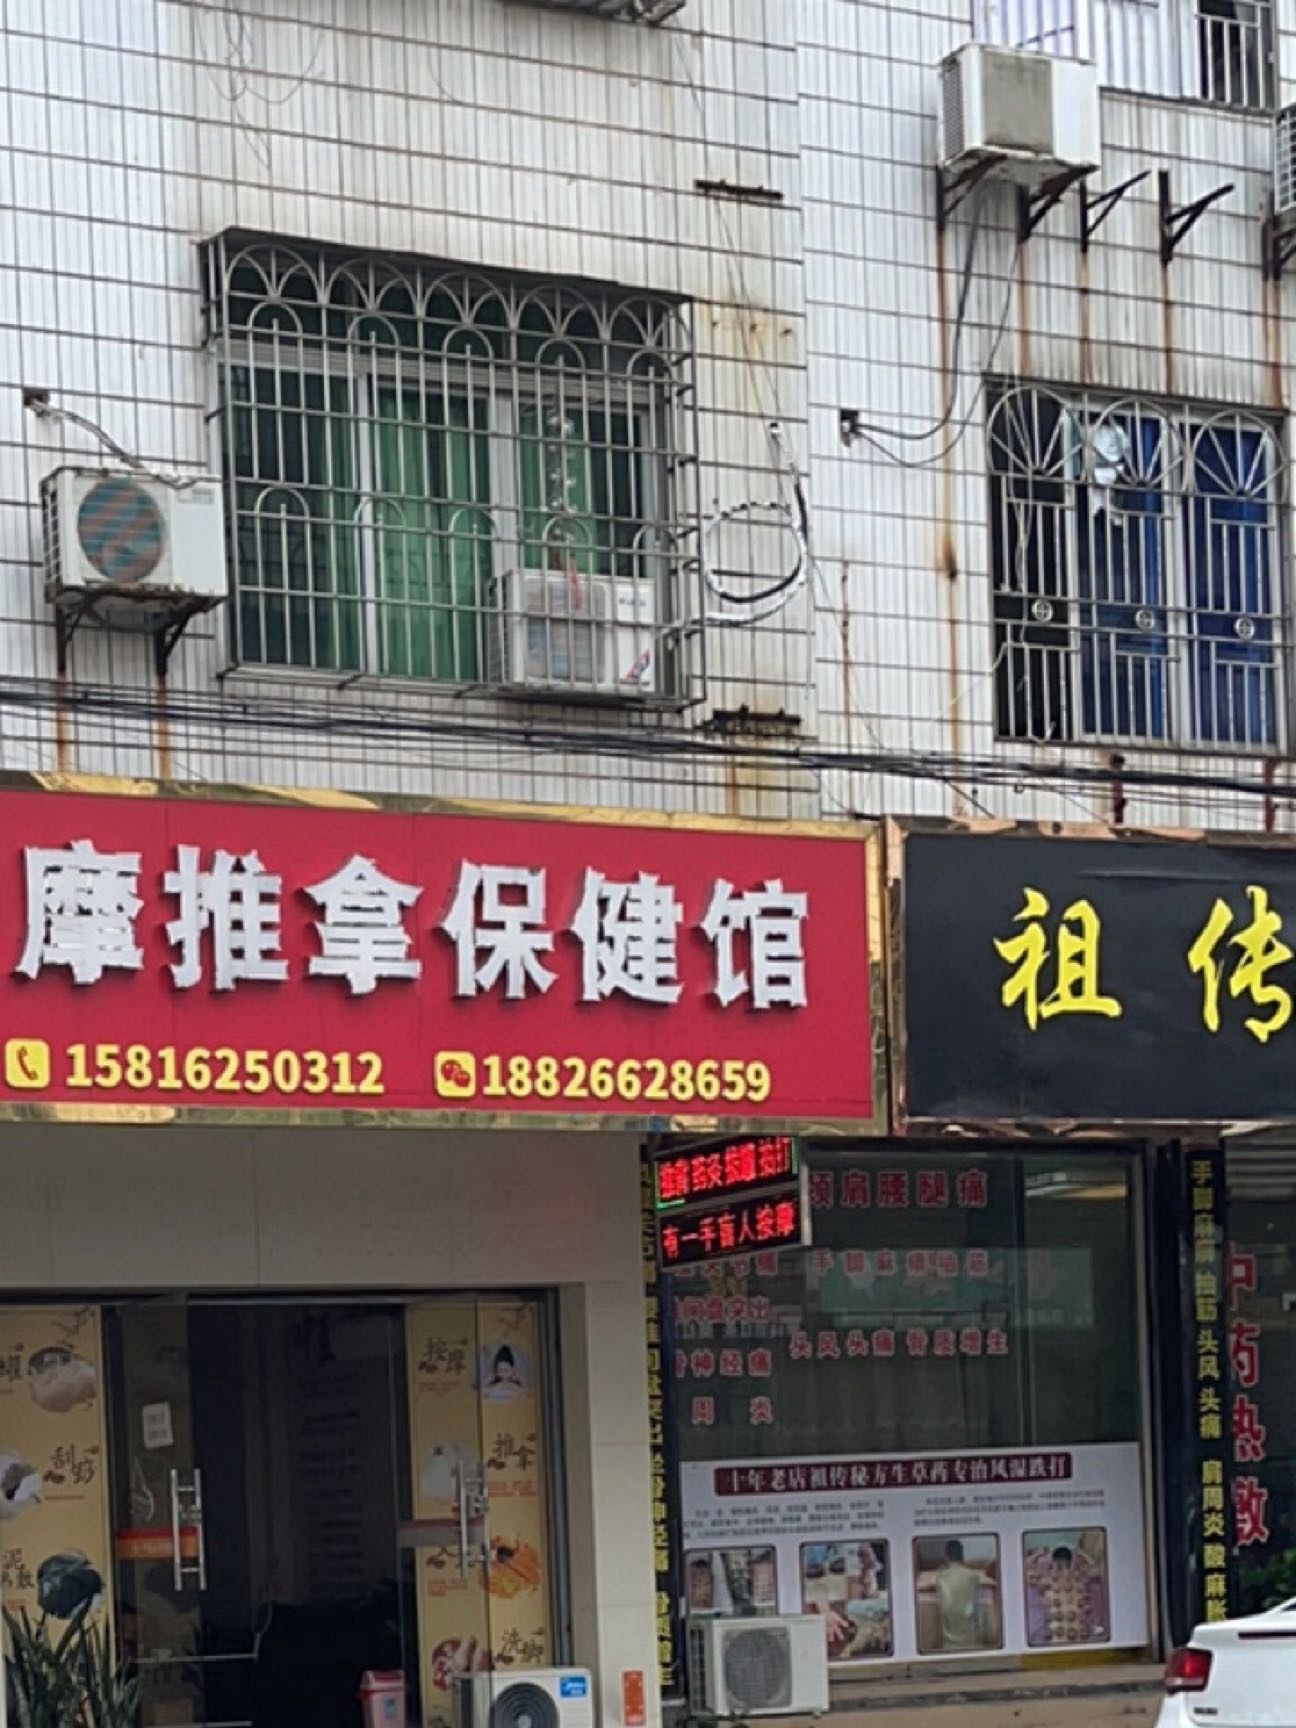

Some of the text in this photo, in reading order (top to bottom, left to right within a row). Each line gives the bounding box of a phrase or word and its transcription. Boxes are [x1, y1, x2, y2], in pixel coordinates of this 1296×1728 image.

[993, 885, 1296, 1044] 祖传
[65, 1043, 385, 1095] 15816250312
[483, 1054, 772, 1102] 18826628659
[663, 1202, 795, 1259] 有一手盲人按摩
